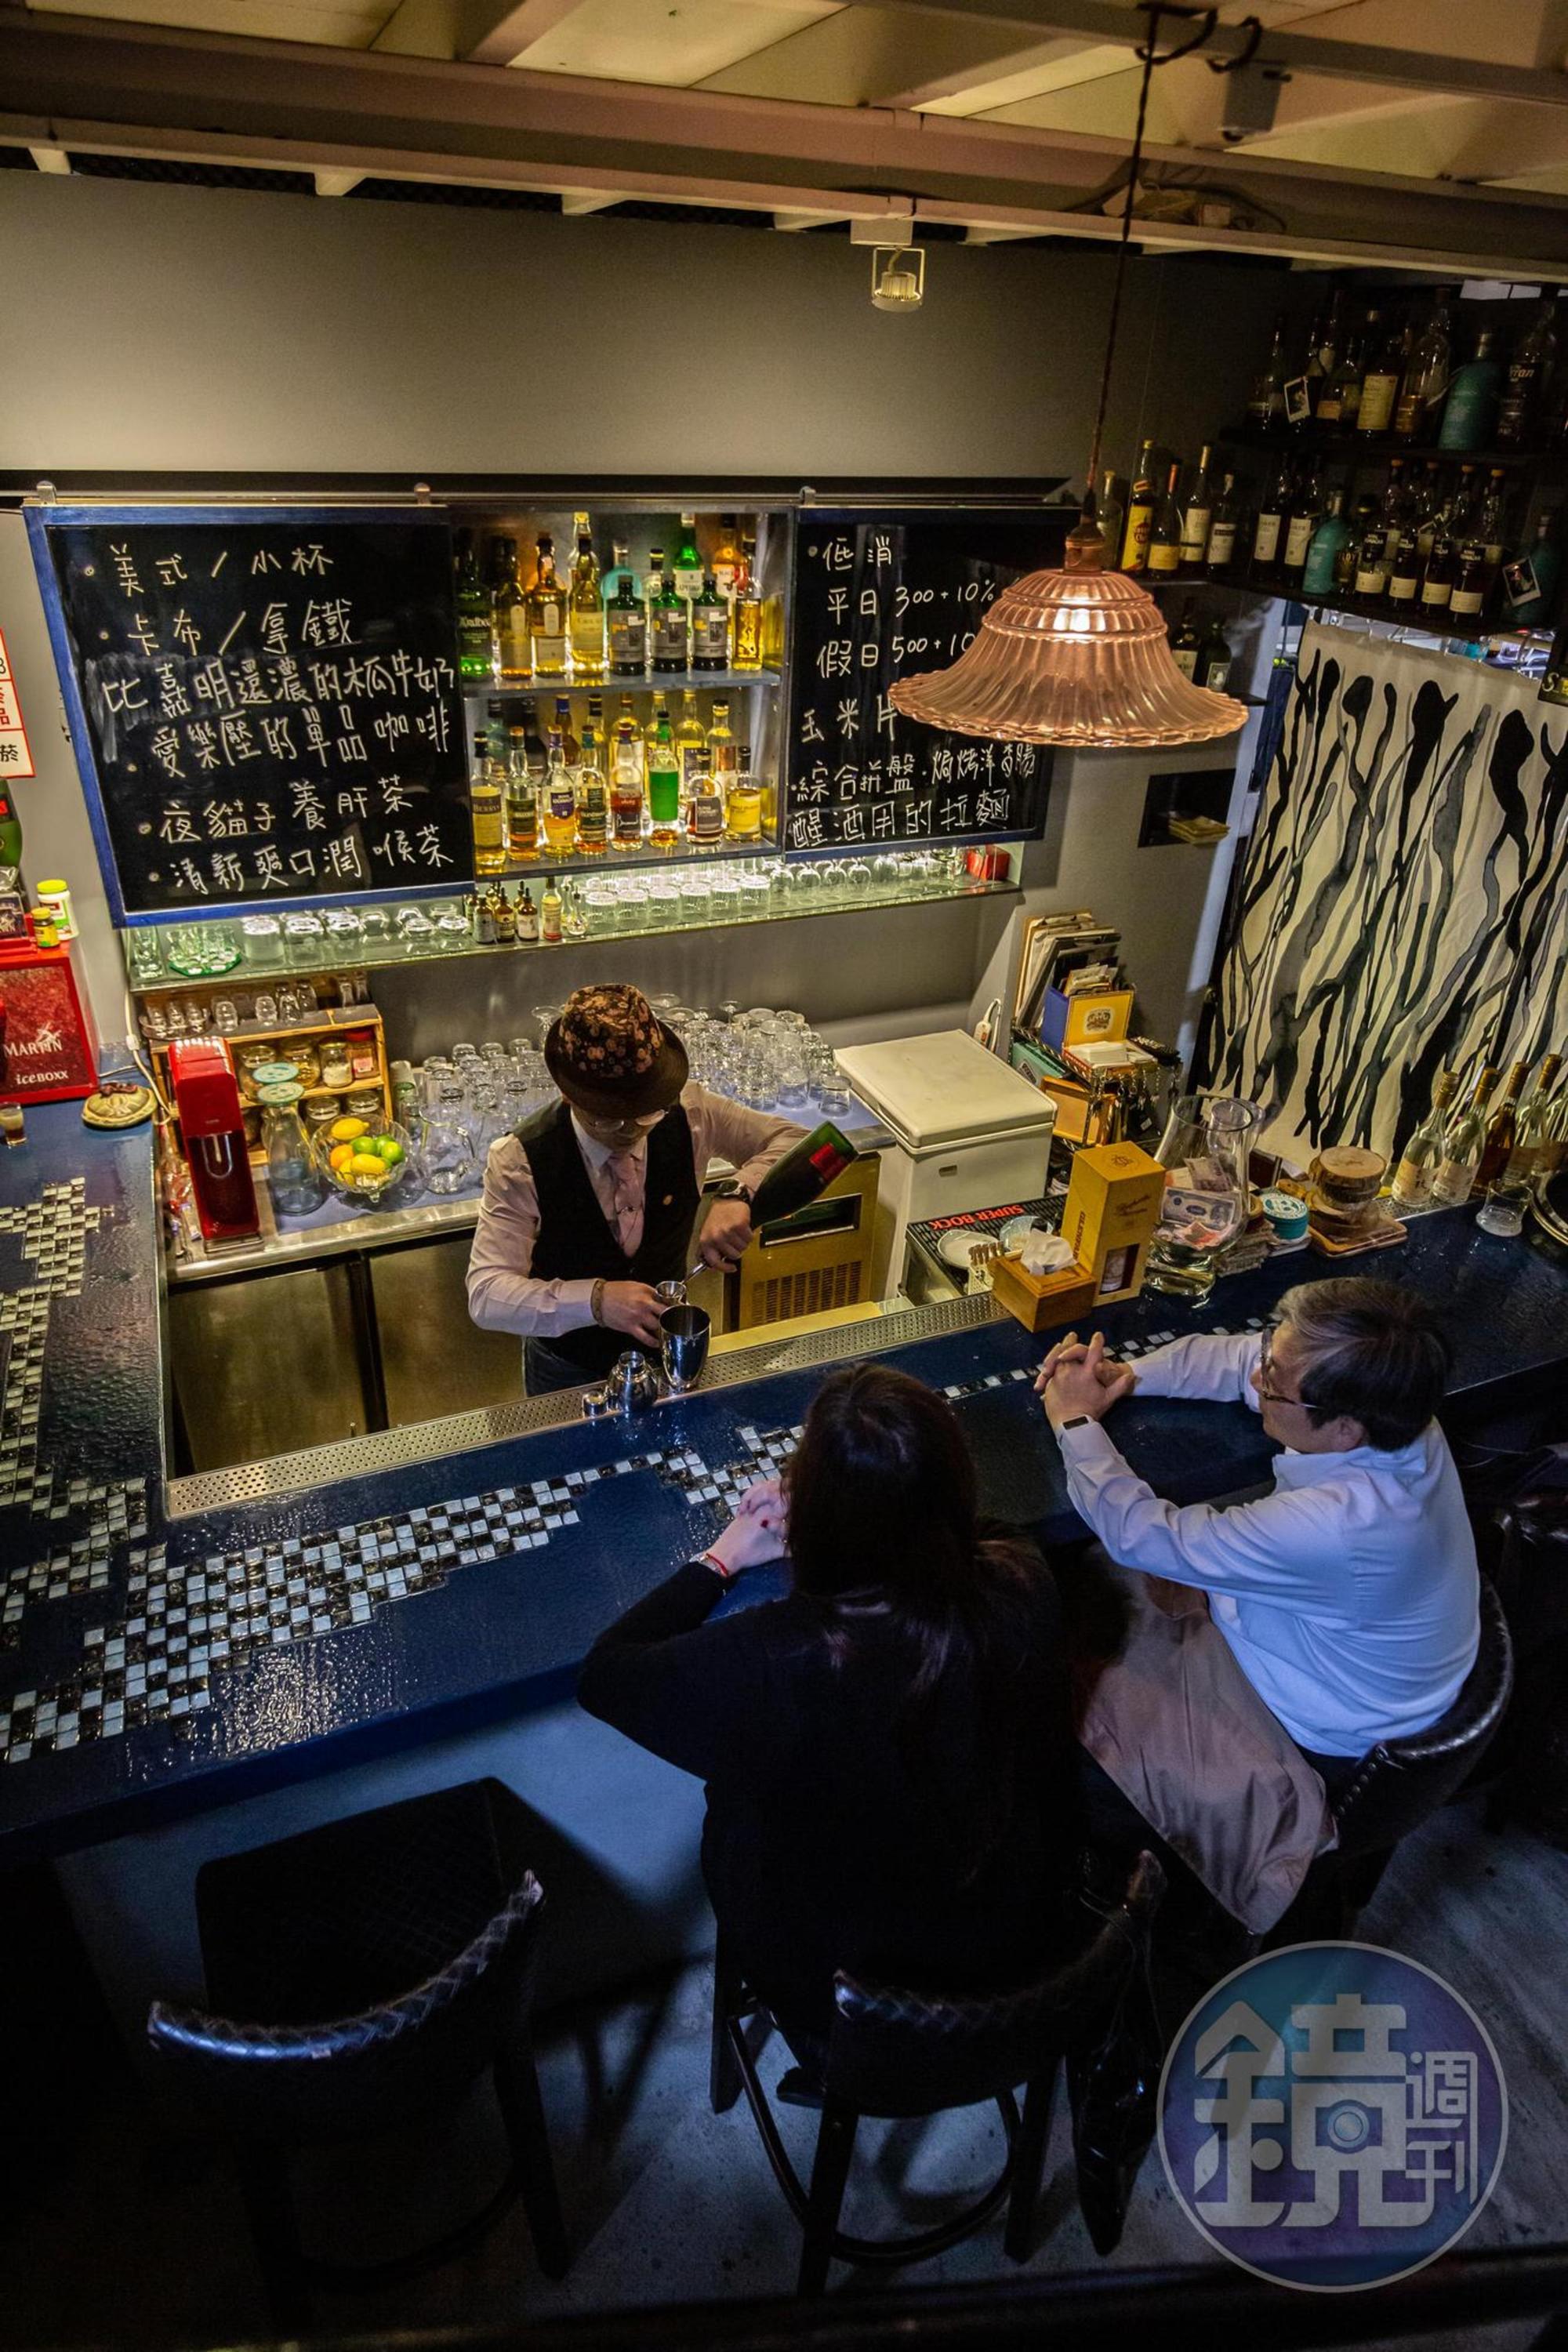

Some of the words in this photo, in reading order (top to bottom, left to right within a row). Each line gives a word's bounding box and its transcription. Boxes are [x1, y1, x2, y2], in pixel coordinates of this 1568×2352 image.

[822, 535, 892, 572] 低消
[827, 586, 879, 626] 平日
[817, 640, 880, 679] 假日
[928, 1214, 976, 1230] BOCK
[975, 1204, 1024, 1221] SUPER
